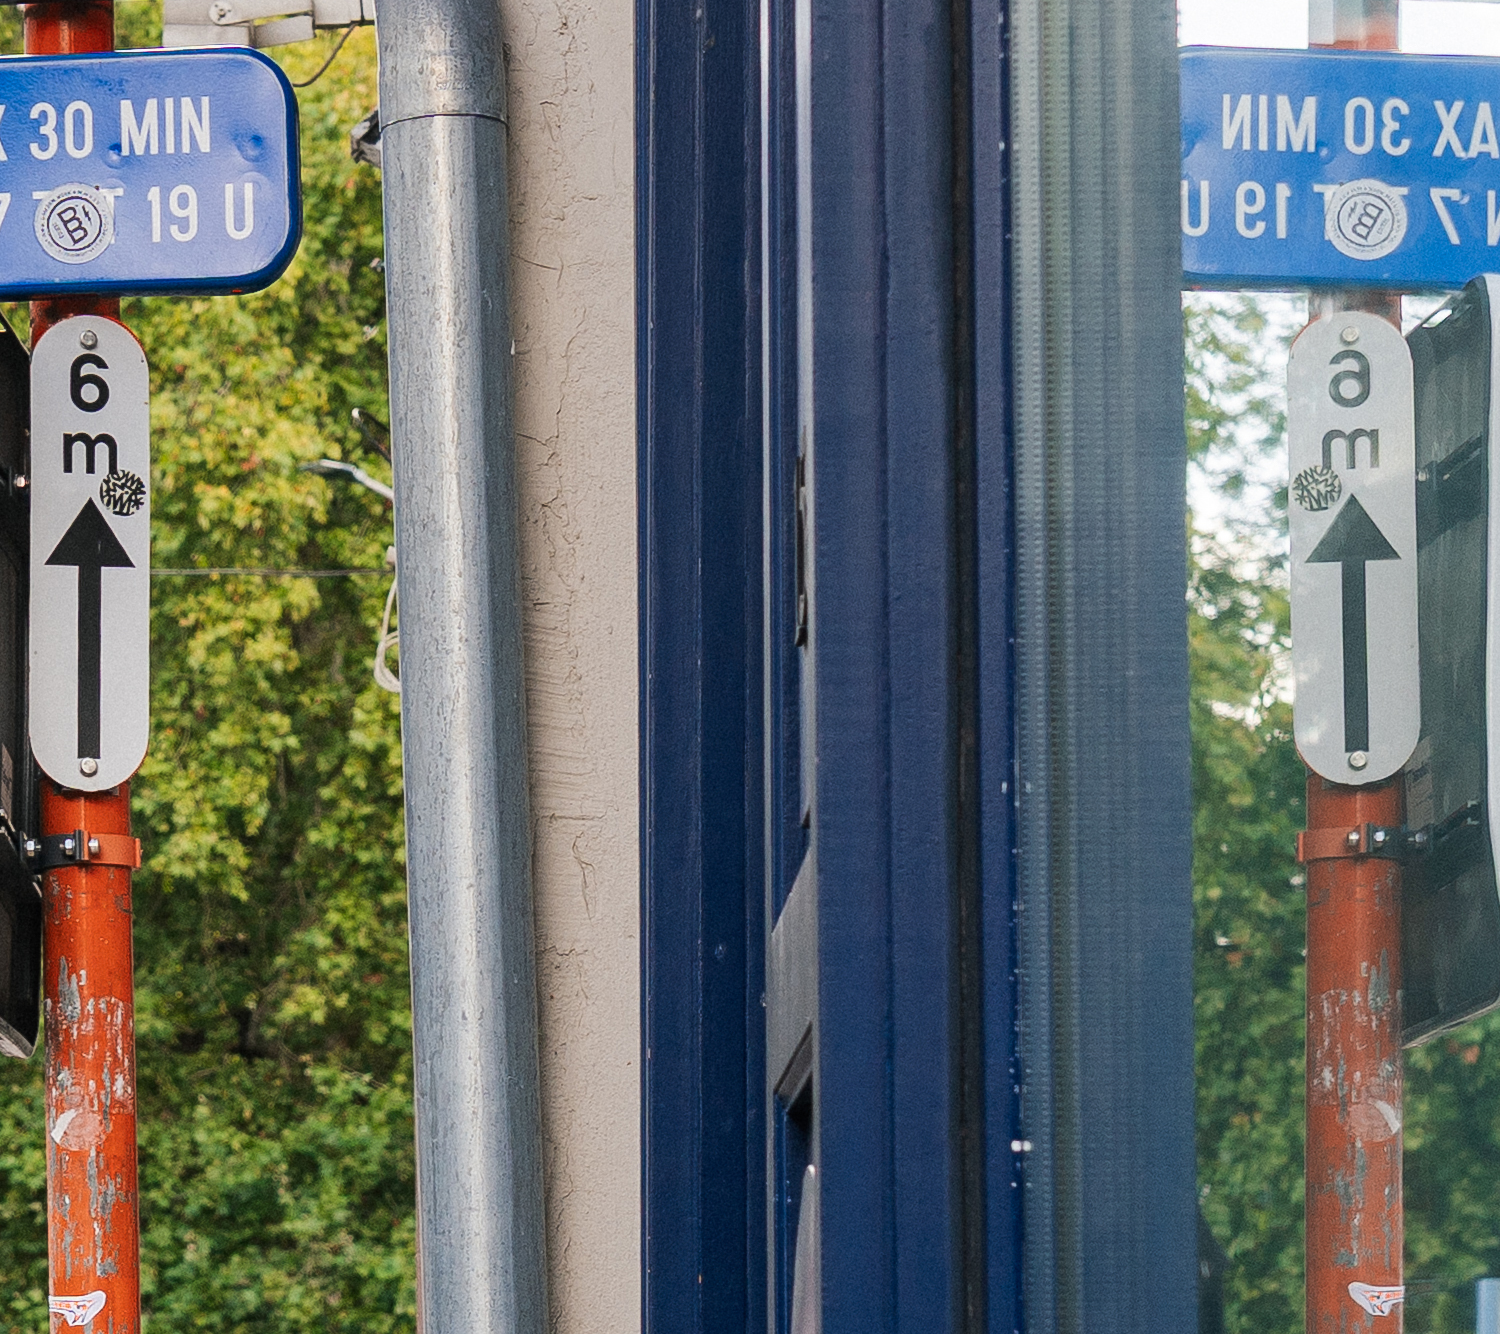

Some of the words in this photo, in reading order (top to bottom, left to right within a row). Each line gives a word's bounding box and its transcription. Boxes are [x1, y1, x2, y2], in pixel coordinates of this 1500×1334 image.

[29, 99, 94, 161] 30
[120, 95, 211, 156] MIN
[146, 183, 199, 244] 19
[224, 181, 255, 241] U
[70, 353, 110, 413] 6
[62, 432, 118, 475] m
